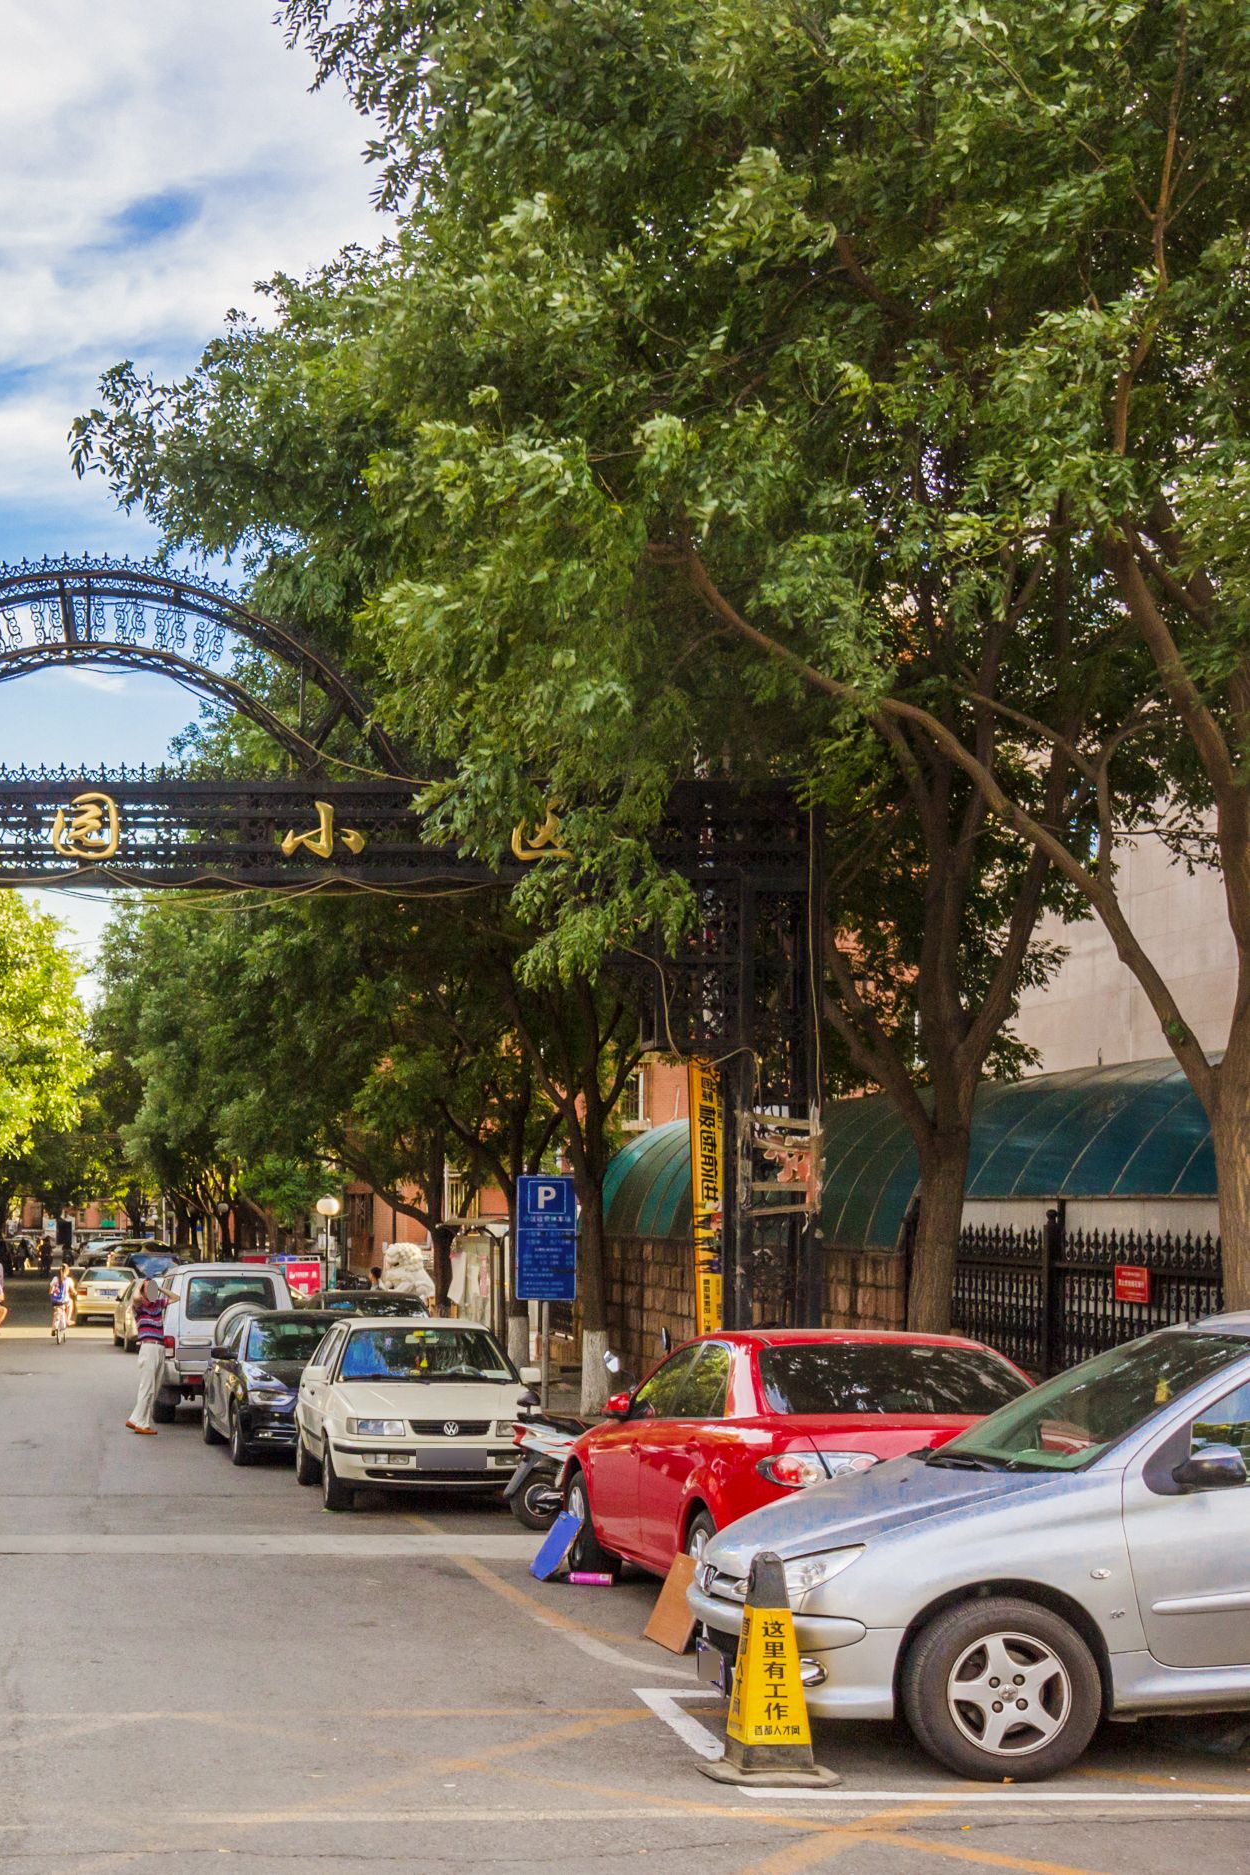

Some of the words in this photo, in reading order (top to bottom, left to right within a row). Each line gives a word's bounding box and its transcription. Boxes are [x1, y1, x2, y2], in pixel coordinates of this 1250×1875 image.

[537, 1185, 557, 1210] P
[761, 1620, 789, 1721] 这里有工作
[754, 1724, 801, 1736] 首都人才网
